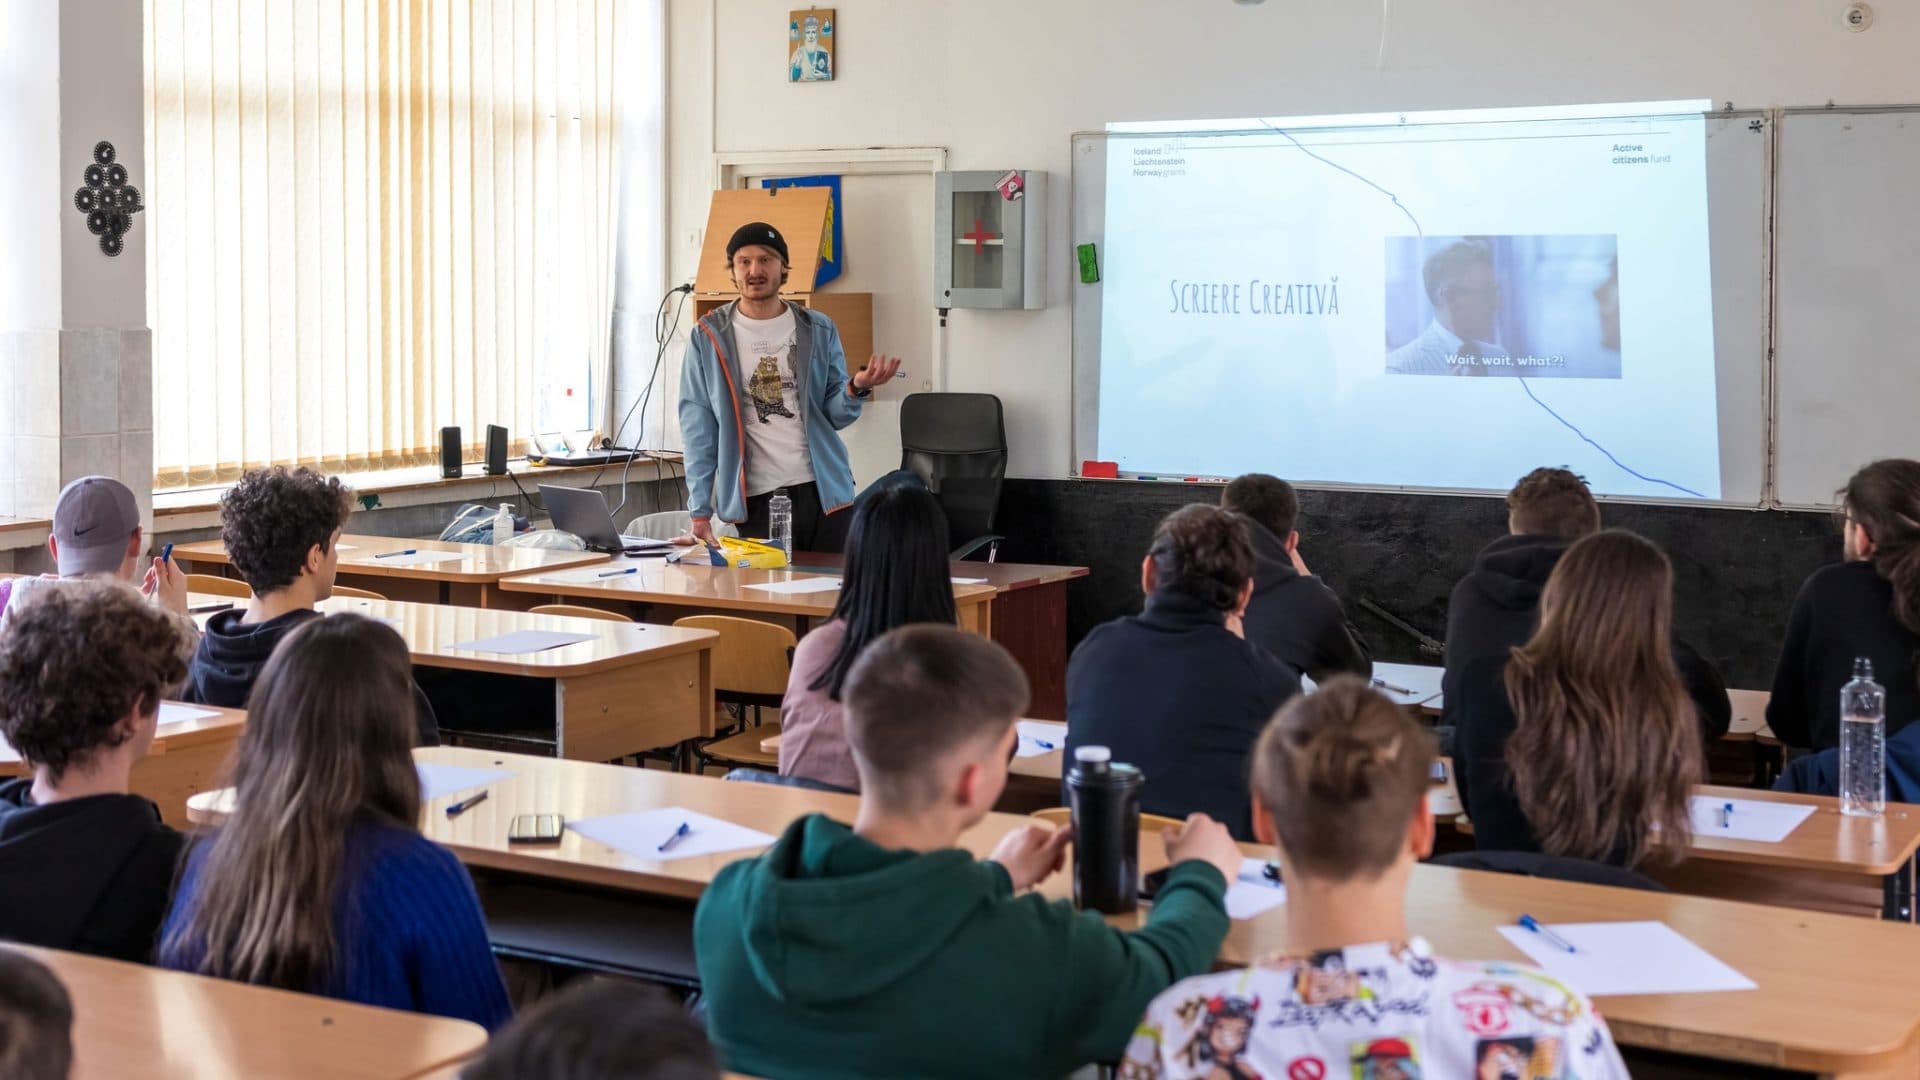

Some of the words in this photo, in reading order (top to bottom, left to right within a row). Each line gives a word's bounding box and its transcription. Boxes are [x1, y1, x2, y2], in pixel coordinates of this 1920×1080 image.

[1133, 146, 1162, 156] Iceland
[1612, 144, 1643, 152] Active
[1133, 158, 1186, 166] Liechtenstein
[1612, 155, 1649, 165] citizens
[1170, 279, 1241, 315] SCRIERE
[1250, 275, 1339, 315] CREATIVĂ
[1445, 353, 1480, 367] Wait,
[1482, 354, 1515, 367] wait,
[1517, 355, 1565, 367] what?!
